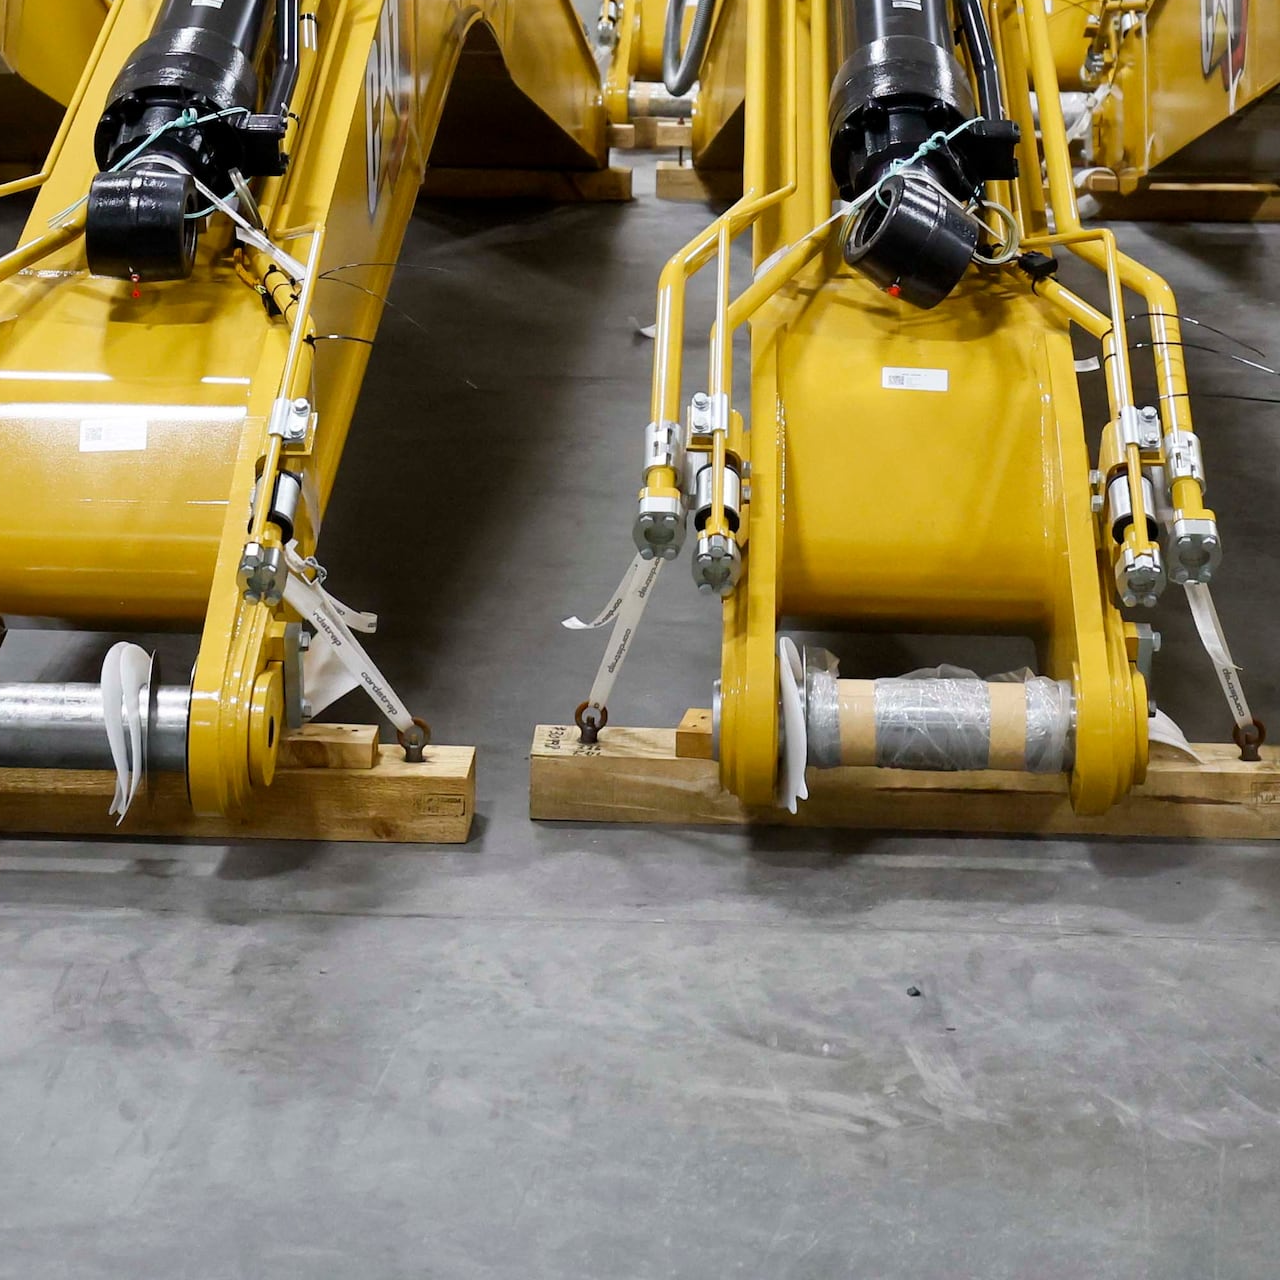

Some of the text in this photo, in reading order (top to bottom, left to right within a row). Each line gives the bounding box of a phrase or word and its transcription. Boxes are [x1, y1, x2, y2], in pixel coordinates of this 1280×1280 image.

[313, 611, 342, 647] rdstrap
[608, 628, 631, 674] cordstrap
[361, 671, 398, 716] cordstrap
[1222, 668, 1245, 717] cordstrap
